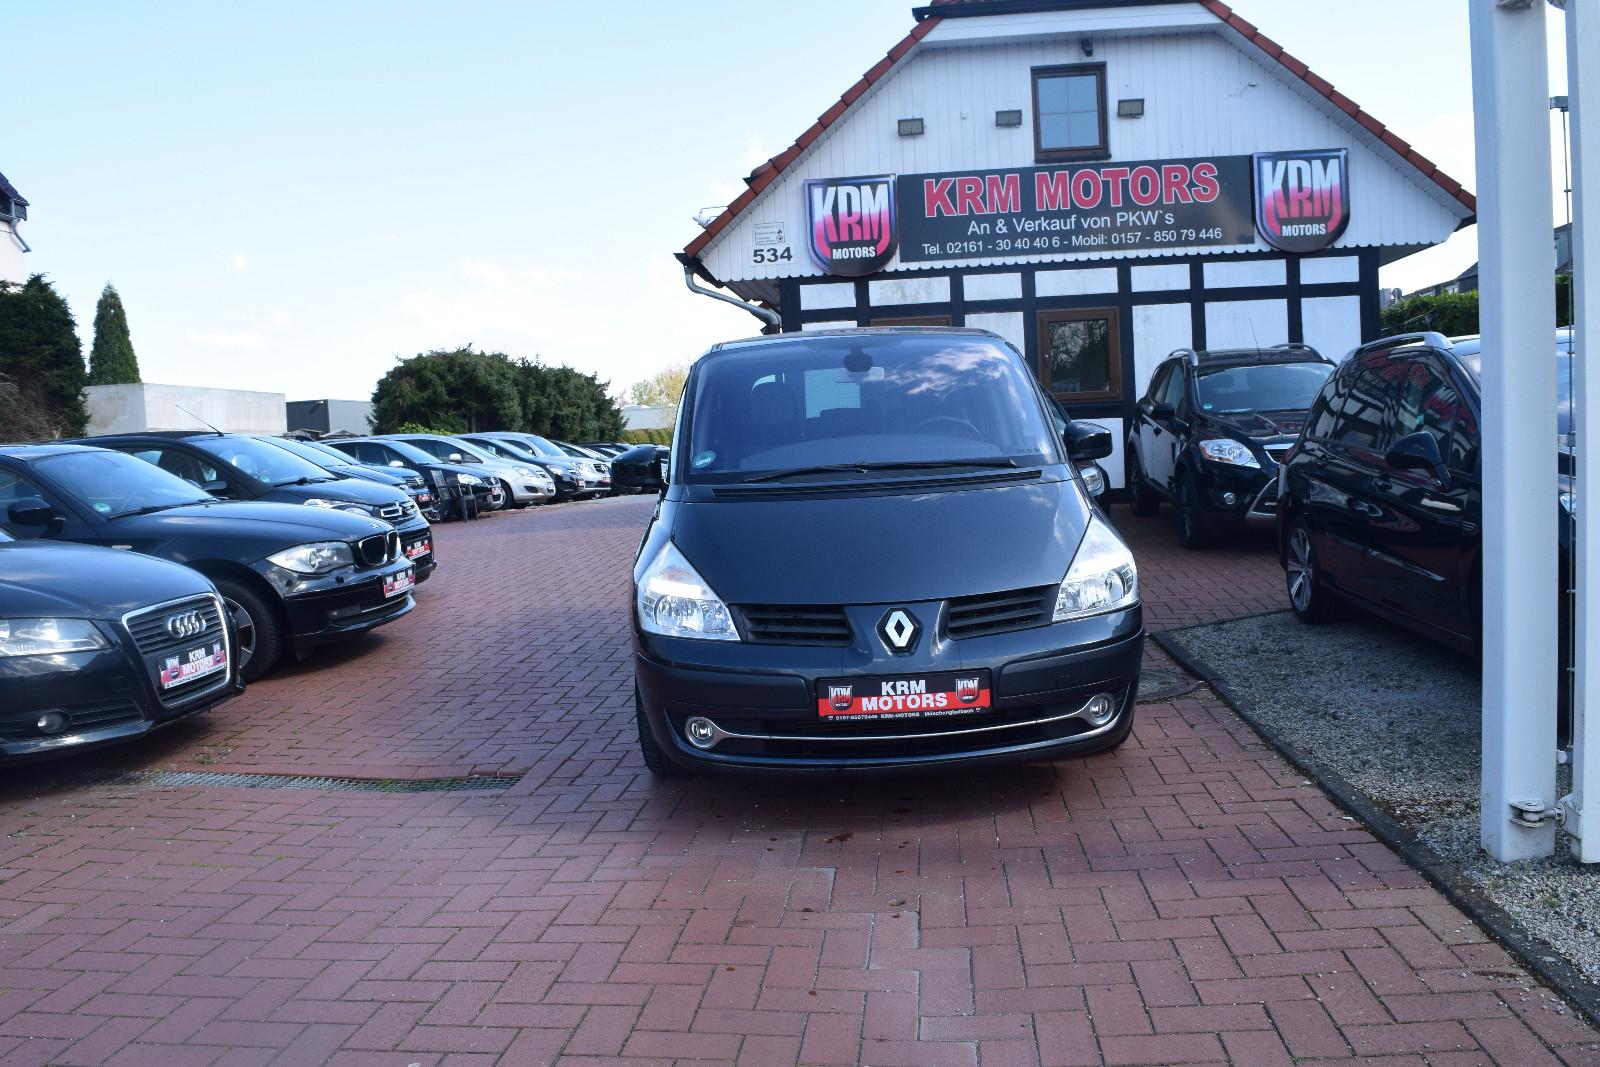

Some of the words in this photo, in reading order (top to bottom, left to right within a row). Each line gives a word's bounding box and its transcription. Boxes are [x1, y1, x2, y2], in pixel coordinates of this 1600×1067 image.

[924, 173, 1021, 218] KRM
[1035, 162, 1219, 212] MOTORS
[1263, 158, 1342, 228] KRM
[812, 183, 892, 250] KRM
[967, 220, 990, 235] An
[995, 218, 1008, 234] &
[1013, 214, 1077, 233] Verkauf
[1080, 215, 1111, 229] von
[1282, 223, 1326, 237] MOTORS
[922, 243, 943, 255] Tel.
[946, 240, 984, 254] 02161
[995, 238, 1012, 251] 30
[1014, 237, 1030, 250] 40
[1033, 236, 1049, 249] 40
[1071, 233, 1108, 247] Mobil:
[1111, 231, 1142, 245] 0157
[1153, 230, 1177, 243] 850
[1180, 228, 1196, 241] 79
[1198, 227, 1223, 240] 446
[752, 246, 793, 264] 534
[831, 245, 876, 260] MOTORS
[189, 647, 206, 662] KRM
[881, 680, 926, 696] KRM
[861, 692, 948, 711] MOTORS
